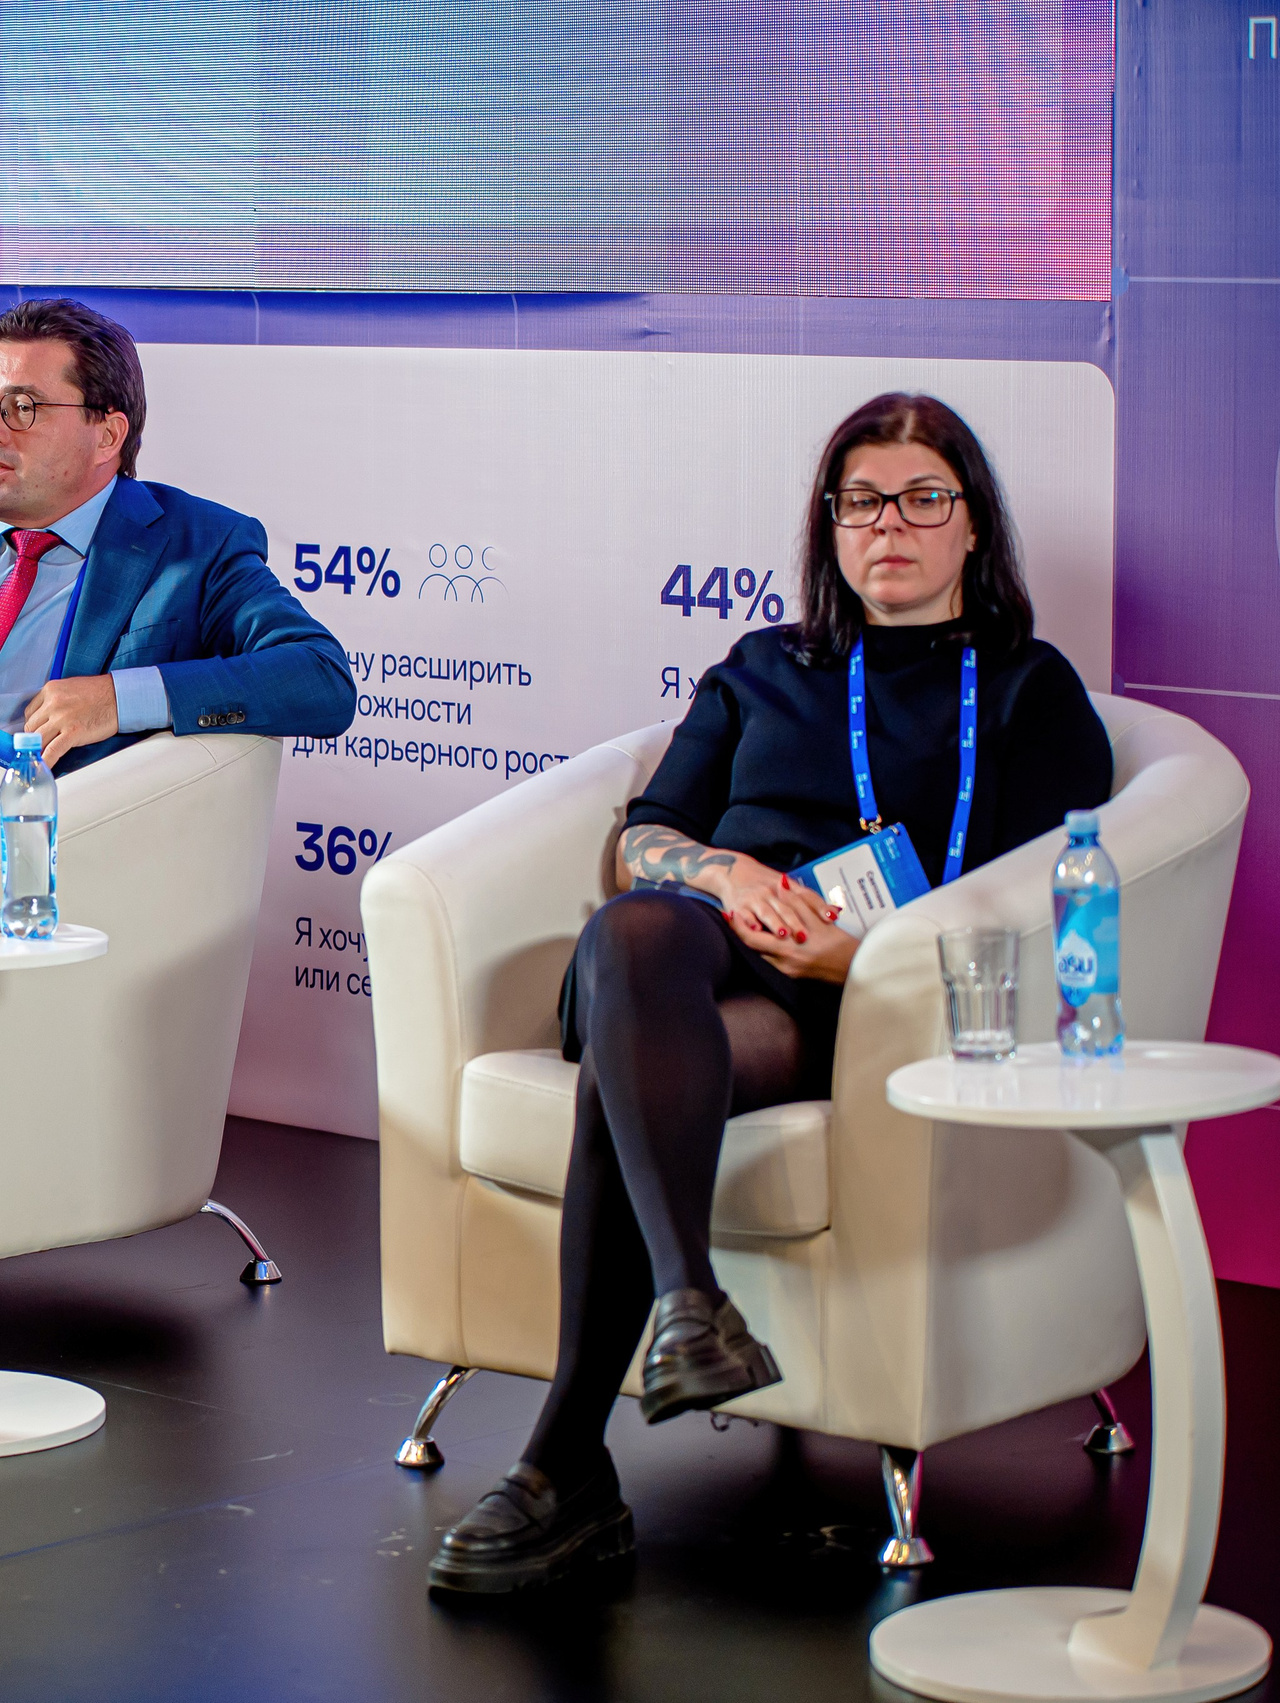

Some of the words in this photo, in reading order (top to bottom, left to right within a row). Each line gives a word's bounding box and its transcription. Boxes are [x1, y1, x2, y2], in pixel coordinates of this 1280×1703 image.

[293, 543, 401, 598] 54%
[660, 564, 785, 624] 44%
[347, 651, 375, 681] чу
[381, 654, 533, 690] расширить
[660, 666, 680, 699] Я
[357, 694, 472, 725] ожности
[345, 735, 498, 772] карьерного
[505, 750, 572, 780] рост
[295, 821, 393, 876] 36%
[295, 917, 312, 947] Я
[295, 965, 340, 992] или
